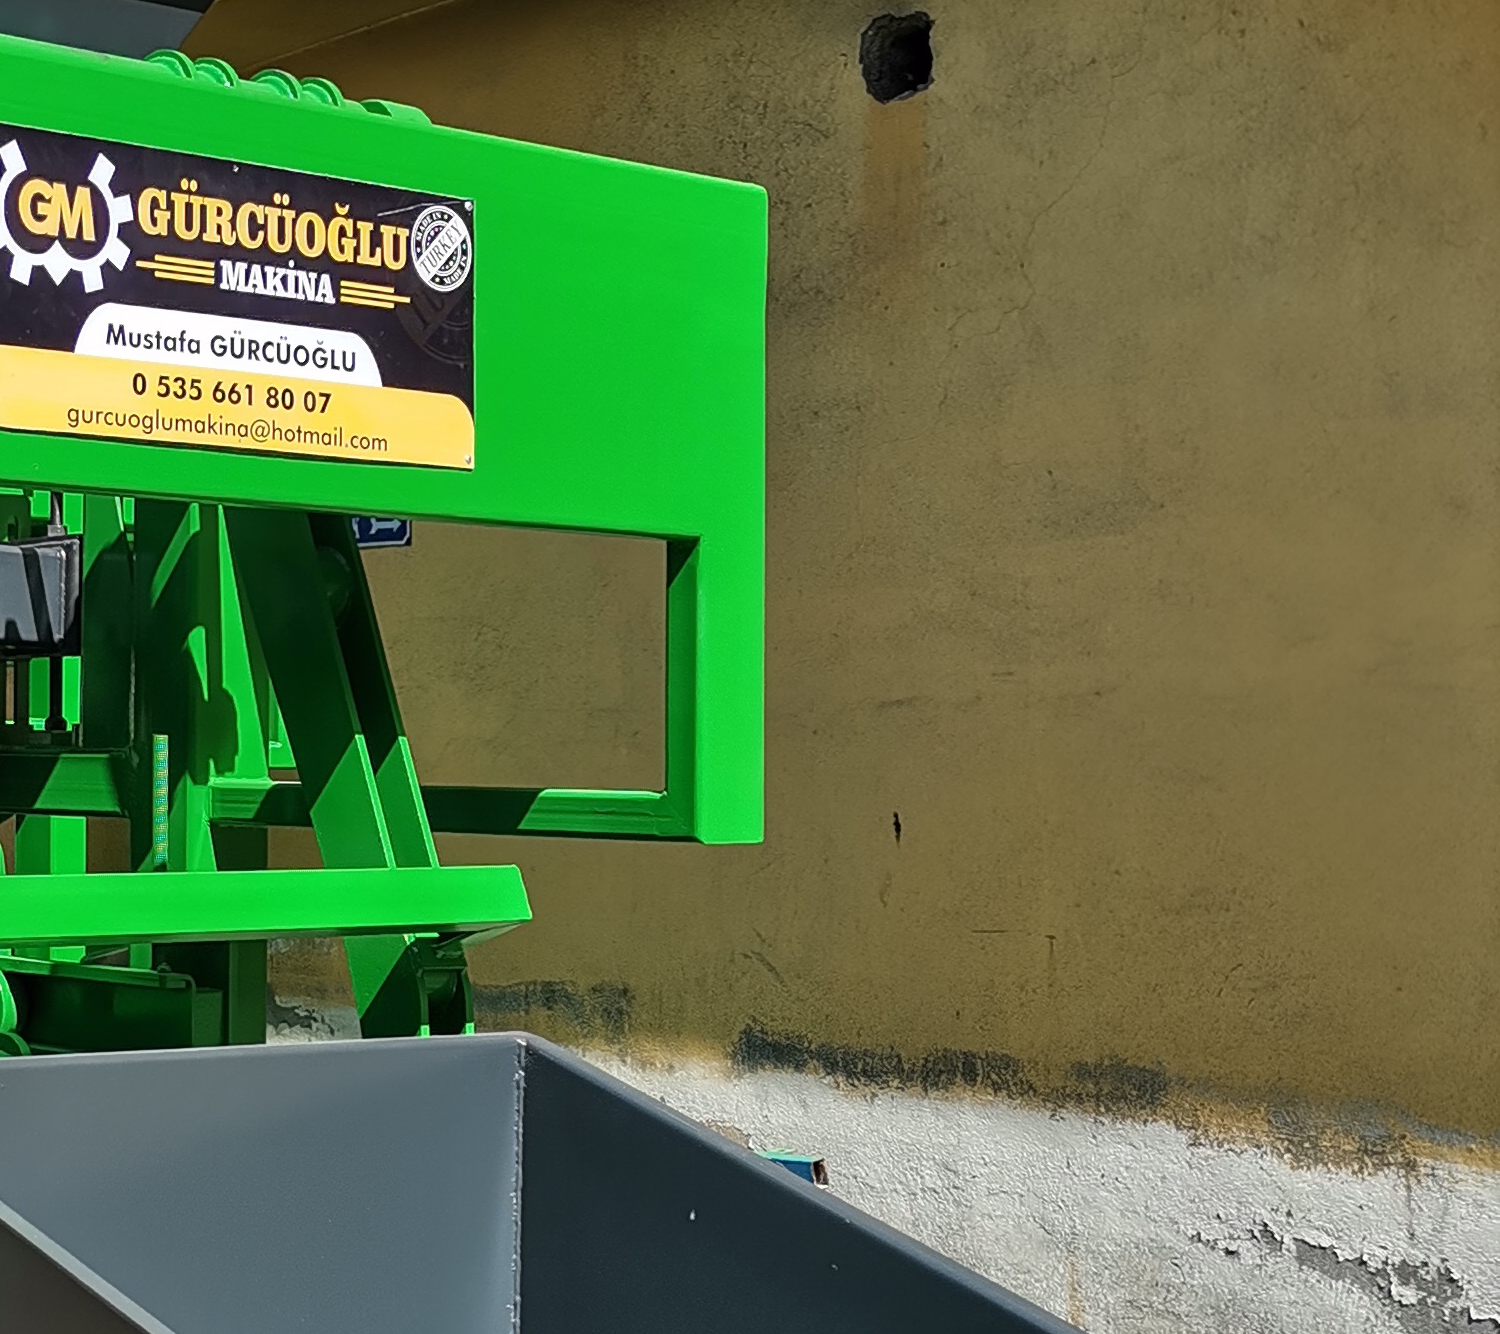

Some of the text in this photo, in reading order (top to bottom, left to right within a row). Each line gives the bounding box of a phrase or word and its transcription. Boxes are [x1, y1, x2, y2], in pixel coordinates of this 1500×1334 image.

[18, 178, 96, 242] GM
[137, 178, 410, 270] GÜRCÜOĞLU
[419, 219, 462, 275] TURKEY
[219, 259, 336, 305] MAKİNA
[106, 323, 356, 373] Mustafa GÜRCÜOĞLU
[132, 373, 332, 415] 0 535 661 80 07
[66, 405, 389, 453] gurcuoglumakina@hotmail.com
